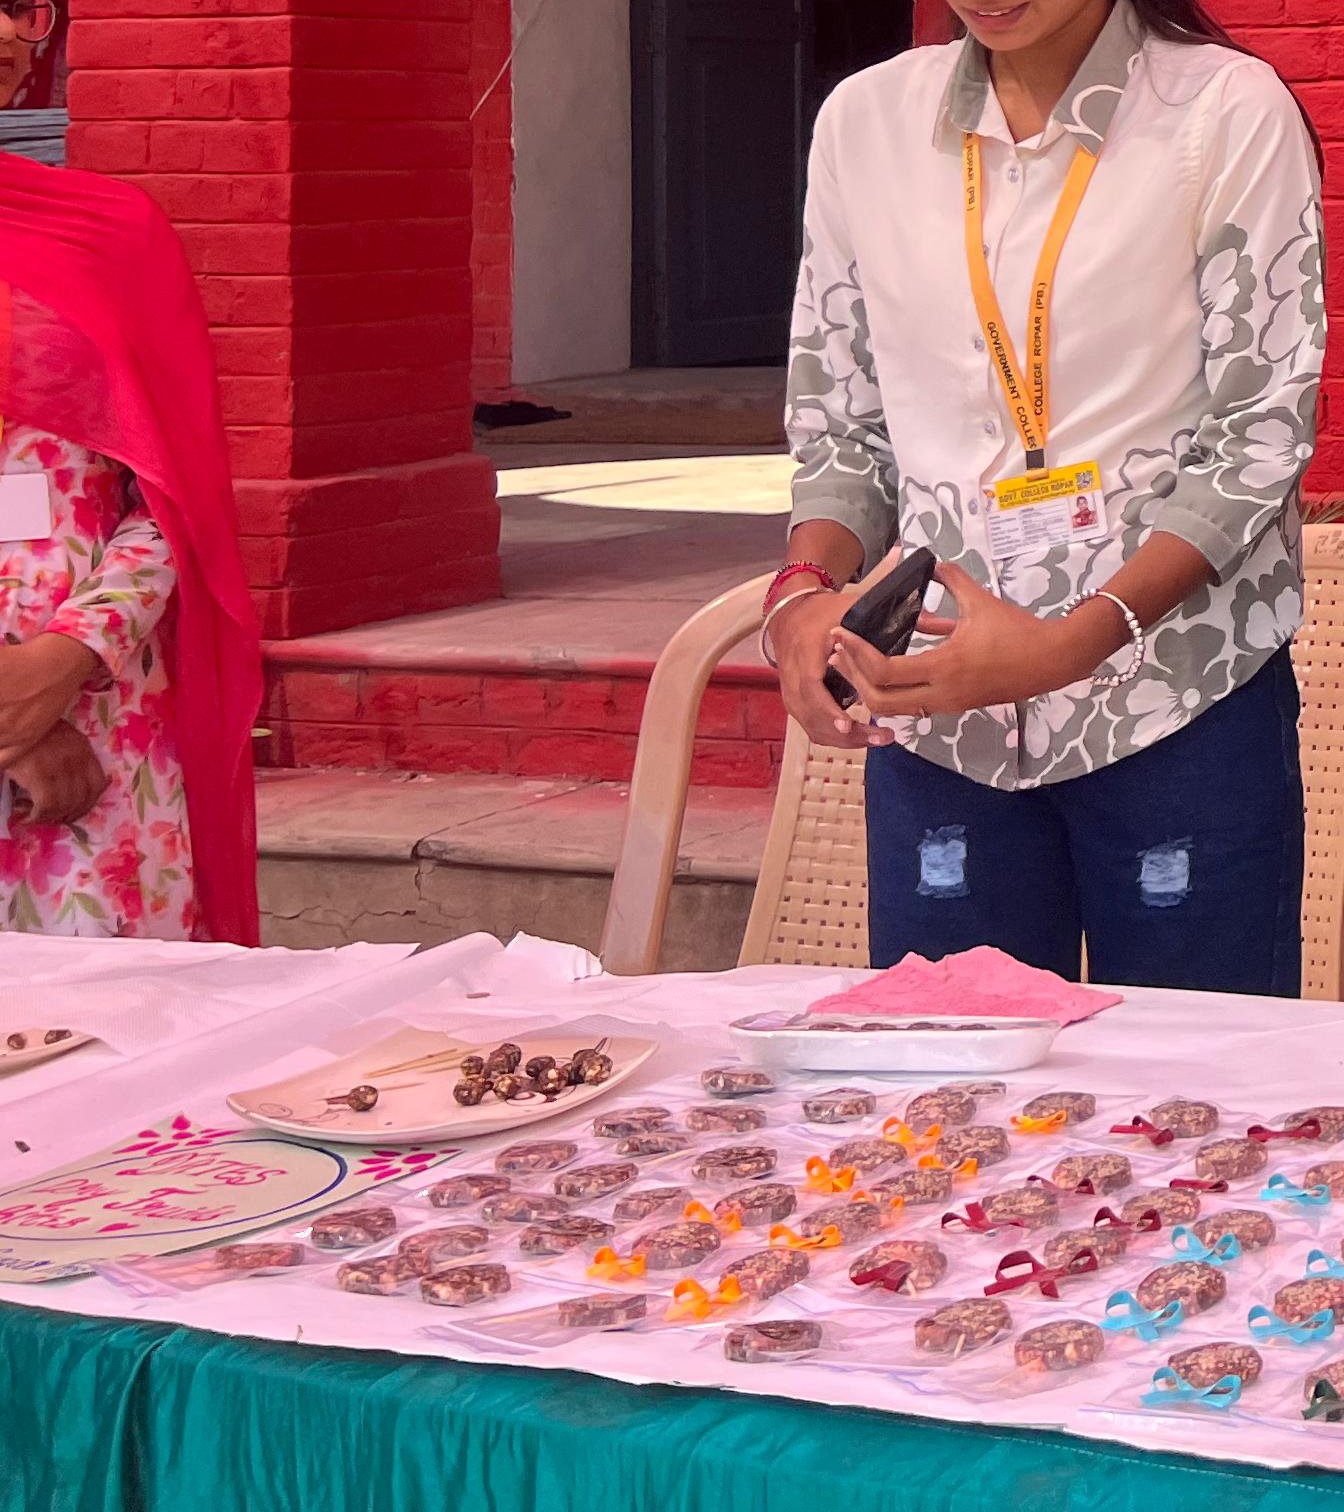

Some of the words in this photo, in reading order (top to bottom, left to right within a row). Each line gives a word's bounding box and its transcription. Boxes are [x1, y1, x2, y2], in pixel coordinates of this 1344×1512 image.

[987, 321, 1021, 400] GOVERNMENT
[1034, 316, 1043, 357] ROPAR
[1034, 363, 1044, 416] COLLEGE
